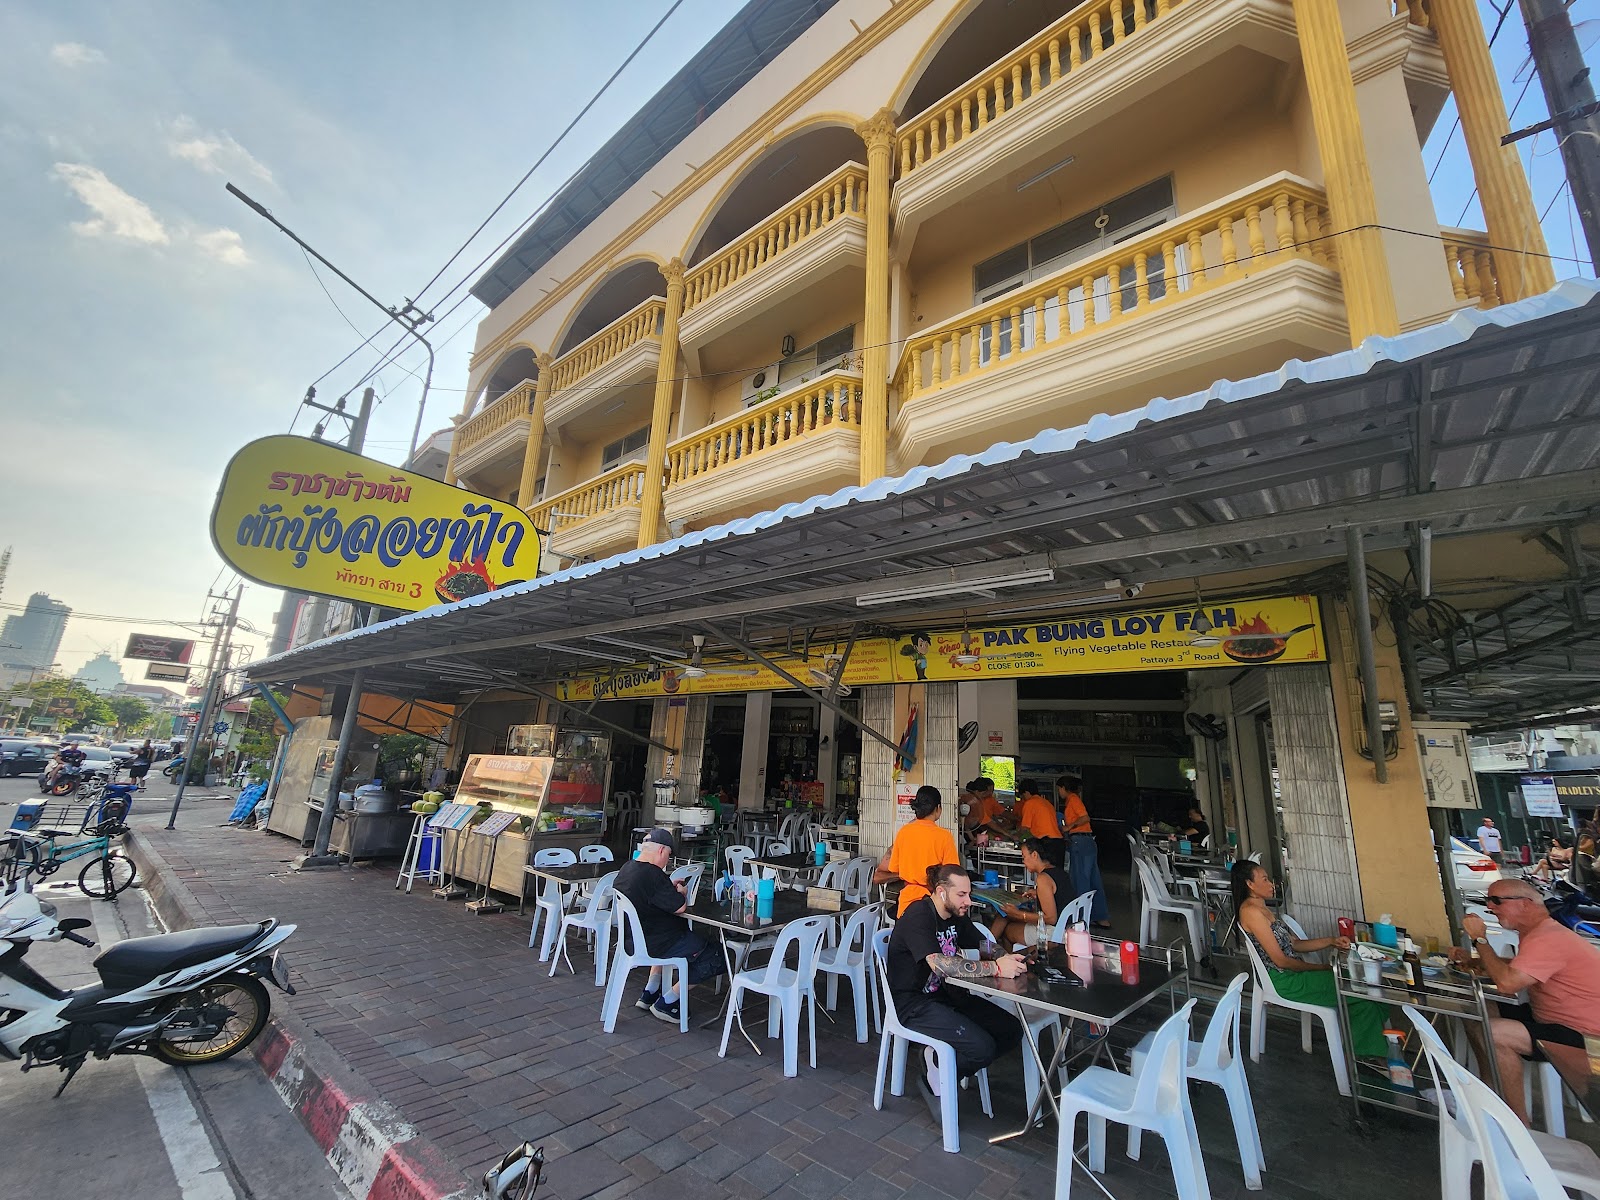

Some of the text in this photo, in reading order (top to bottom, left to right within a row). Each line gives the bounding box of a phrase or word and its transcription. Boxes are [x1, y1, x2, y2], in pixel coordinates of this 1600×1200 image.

[268, 470, 412, 504] ราชาข้าวต้ม
[236, 502, 525, 568] ผักบุ้งลอยฟ้า
[335, 567, 423, 599] พัทยา สาย 3
[983, 628, 1030, 647] PAK
[1036, 619, 1105, 643] BUNG
[1111, 613, 1165, 637] LOY
[938, 642, 961, 656] Khao
[1054, 646, 1086, 658] Flying
[1089, 641, 1147, 655] Vegetable
[987, 662, 1012, 671] CLOSE
[1014, 660, 1036, 669] 01:30
[1140, 656, 1174, 665] Pattaya
[1194, 652, 1220, 662] Road
[1557, 786, 1600, 796] BRADLEY'S
